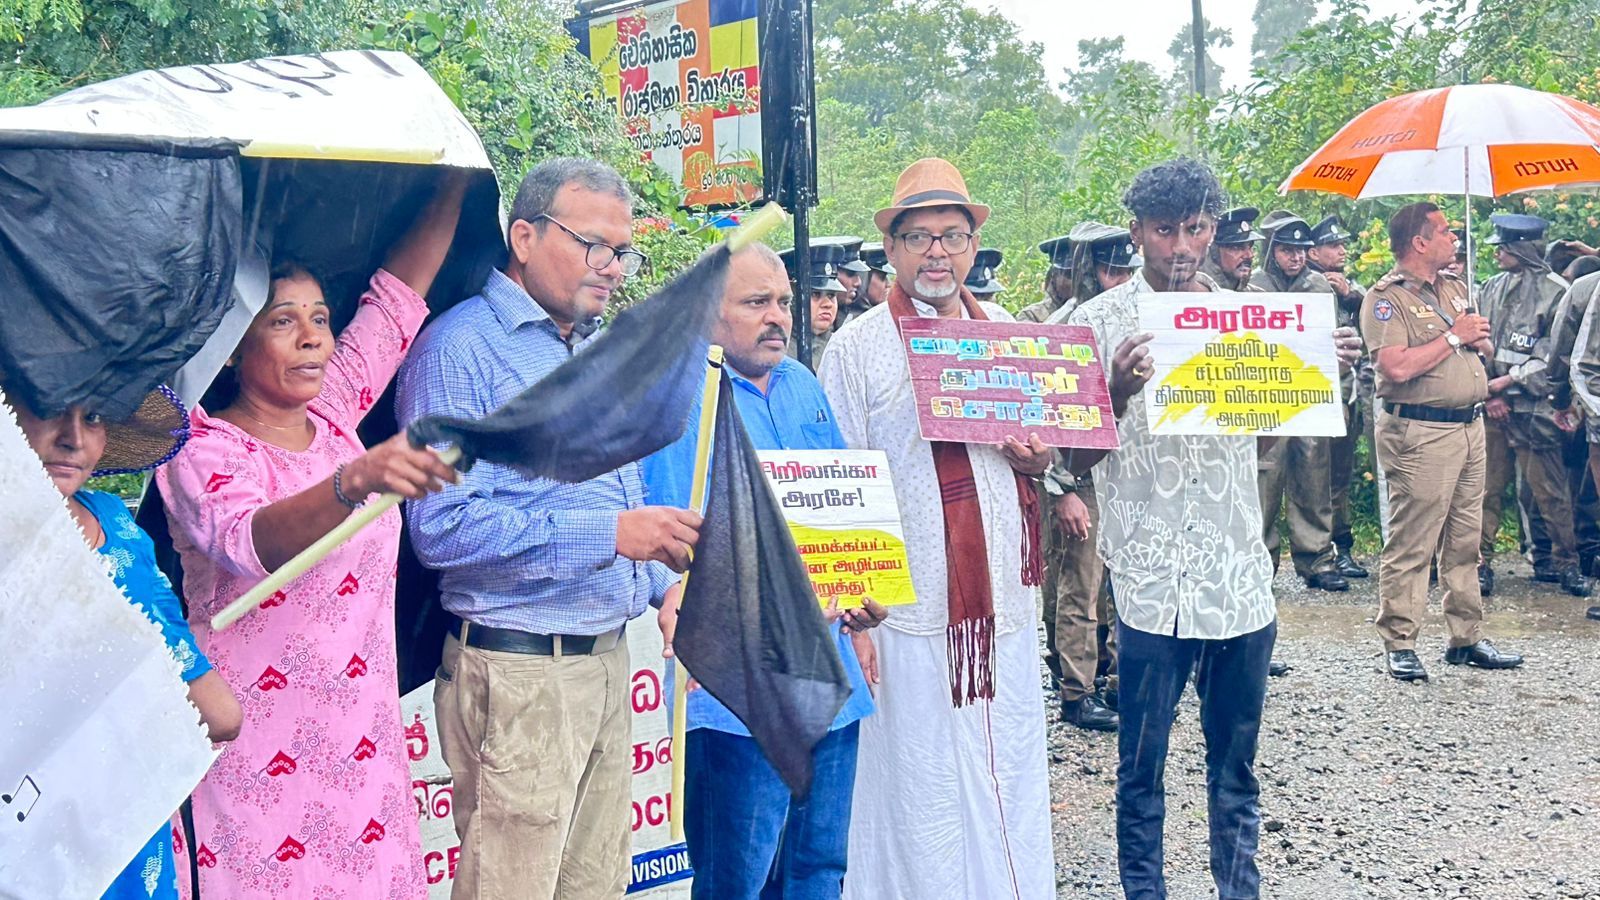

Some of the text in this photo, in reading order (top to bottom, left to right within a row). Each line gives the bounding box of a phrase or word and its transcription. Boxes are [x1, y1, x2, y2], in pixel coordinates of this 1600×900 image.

[619, 24, 697, 69] ඓතිහාසික
[1174, 304, 1305, 334] அரசே!
[909, 336, 1098, 367] தையிட்டி
[1204, 339, 1280, 361] தையிட்டி
[939, 365, 1080, 397] தமிழர்
[1195, 362, 1293, 384] சட்டவிரோத
[1225, 385, 1334, 407] விகாரையை
[930, 396, 1103, 430] சொத்து
[1216, 409, 1281, 432] அகற்று!
[782, 487, 865, 510] அரசே!
[797, 537, 893, 555] மைக்கப்பட்ட
[833, 557, 902, 576] அழிப்பை
[629, 850, 689, 885] IVISION
